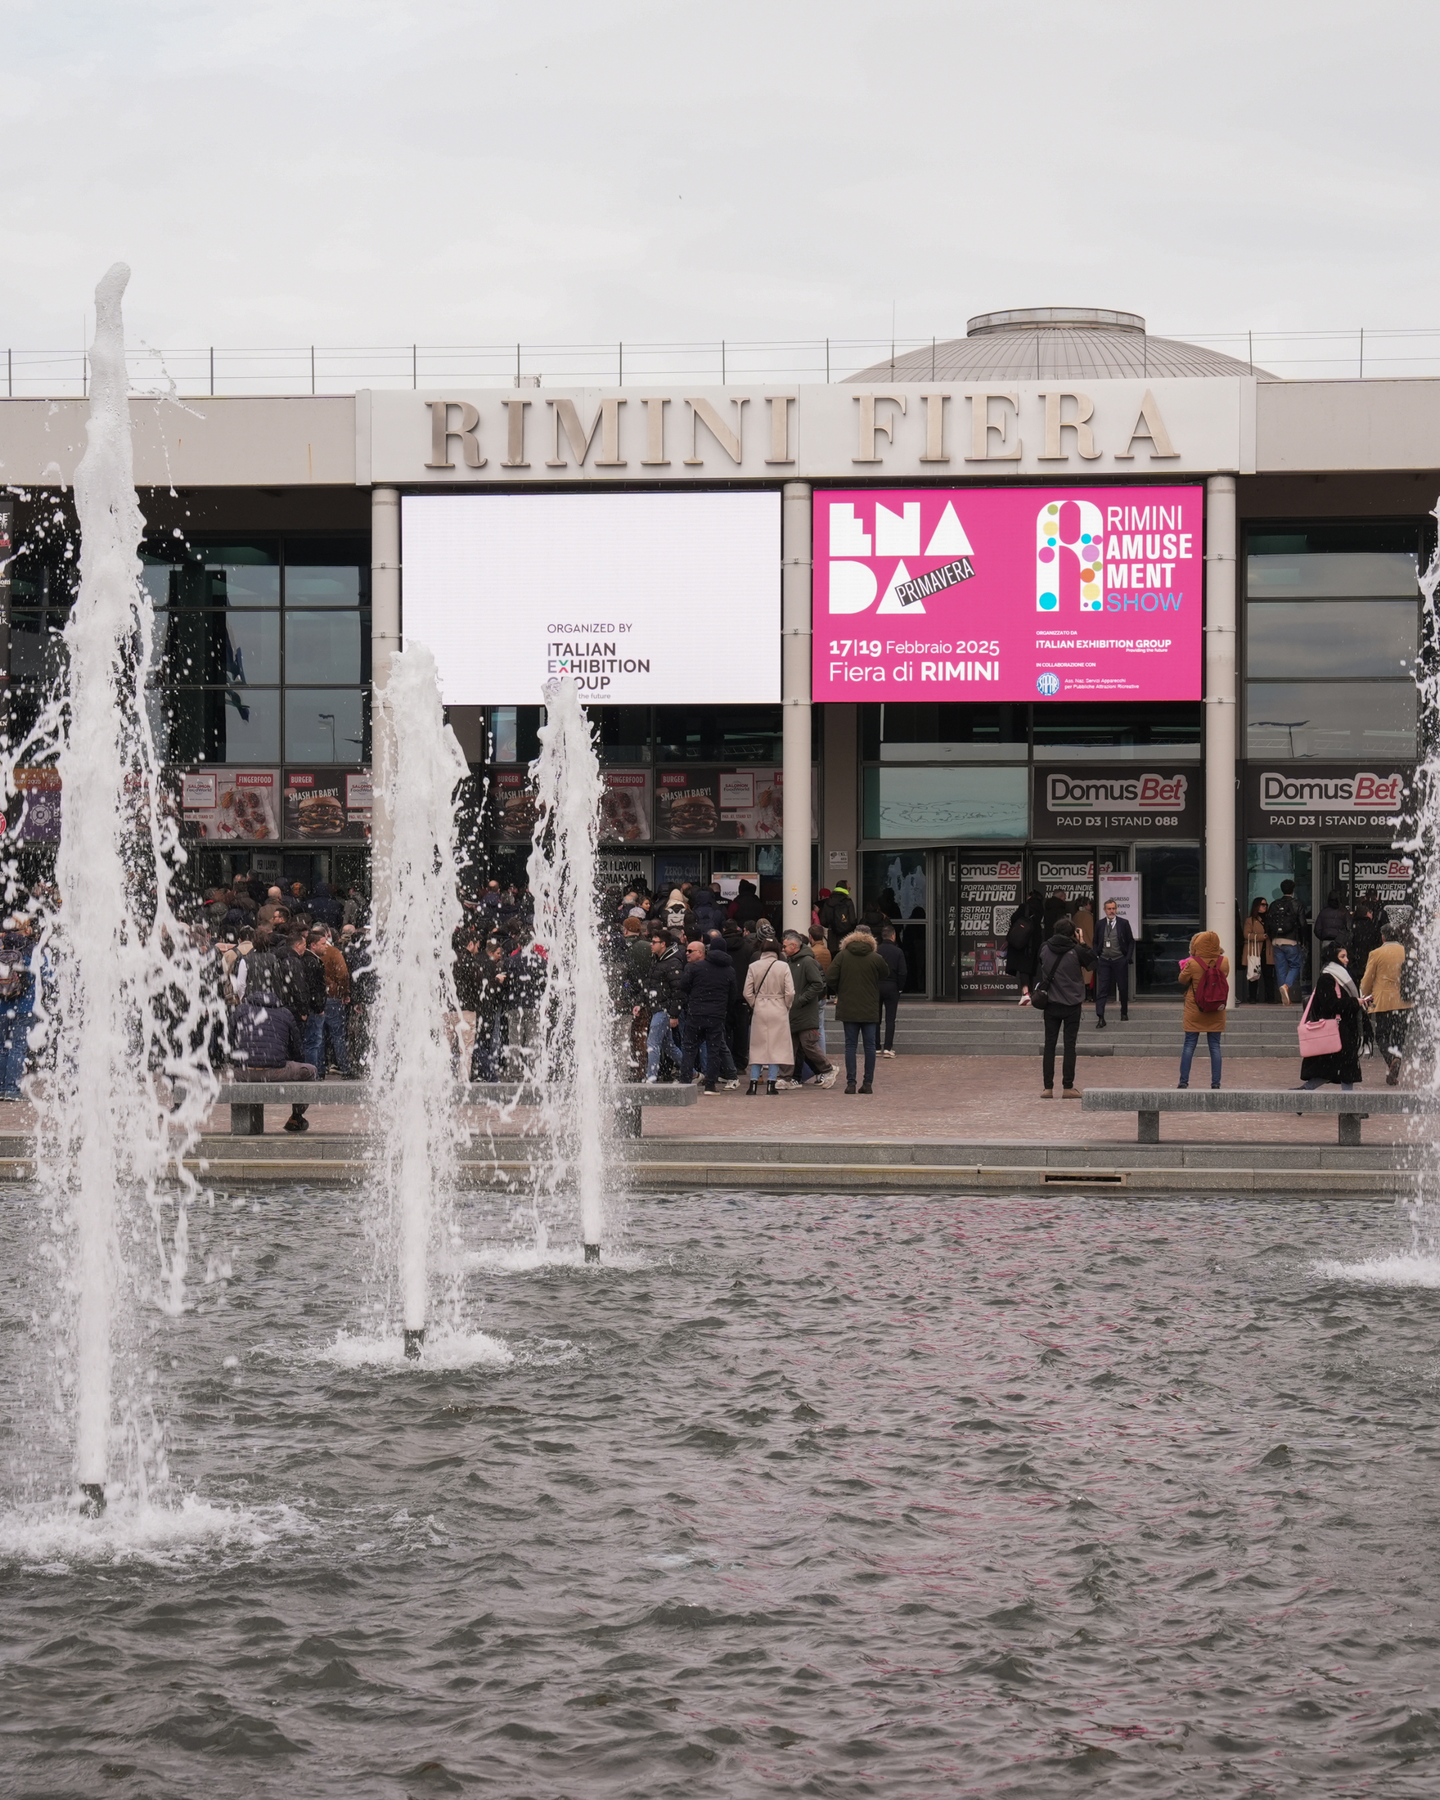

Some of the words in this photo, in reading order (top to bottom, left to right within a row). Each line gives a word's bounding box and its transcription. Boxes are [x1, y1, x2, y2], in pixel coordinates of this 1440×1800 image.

[424, 397, 796, 468] RIMINI
[852, 388, 1181, 462] FIERA
[1107, 506, 1182, 531] RIMINI
[829, 500, 975, 556] ENA
[1106, 534, 1193, 560] AMUSE
[895, 558, 975, 606] PRIMAVERA
[1107, 563, 1176, 588] MENT
[1106, 592, 1183, 612] SHOW
[547, 624, 615, 633] ORGANIZED
[619, 623, 633, 633] BY
[548, 643, 616, 656] ITALIAN
[886, 640, 952, 654] Febbraio
[956, 640, 1000, 656] 2025
[1036, 640, 1074, 648] ITALIAN
[1076, 640, 1133, 648] EXHIBITION
[1136, 639, 1172, 648] GROUP
[548, 659, 650, 673] EXHIBITION
[830, 662, 886, 681] Fiera
[893, 662, 913, 681] di
[921, 661, 999, 681] RIMINI
[239, 776, 272, 784] FINGERFOOD
[289, 792, 311, 802] SMASH
[312, 790, 318, 799] IT
[318, 788, 338, 798] BABY!
[661, 791, 683, 801] SMASH
[684, 790, 690, 798] IT
[691, 787, 711, 797] BABY!
[1051, 778, 1183, 800] DomusBet
[1264, 777, 1399, 799] DomusBet
[495, 791, 517, 801] SMASH
[518, 790, 524, 798] IT
[1056, 817, 1082, 826] PAD
[1086, 817, 1101, 826] D3
[1111, 817, 1151, 826] STAND
[1155, 816, 1178, 826] 088
[1270, 816, 1295, 825] PAD
[1299, 816, 1315, 825] D3
[1325, 816, 1367, 825] STAND
[615, 861, 640, 871] LAVORI
[968, 891, 1016, 901] FUTURO
